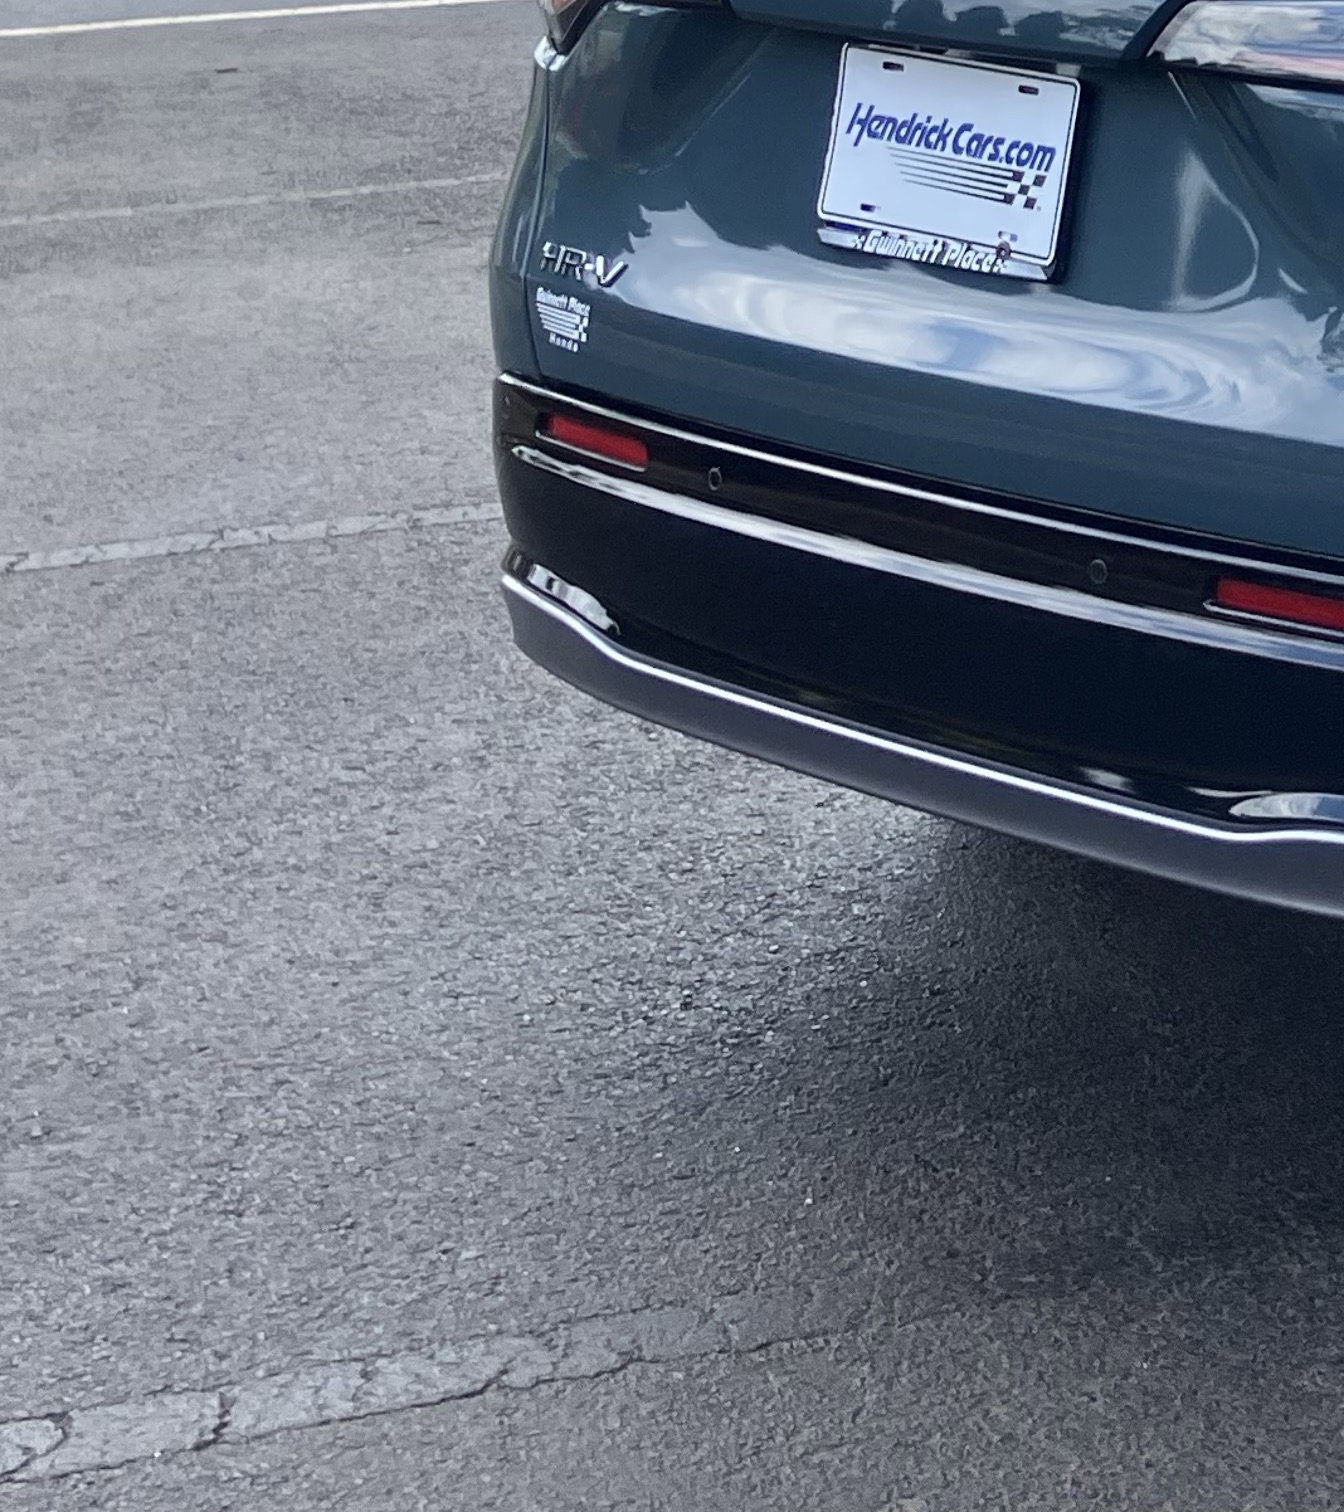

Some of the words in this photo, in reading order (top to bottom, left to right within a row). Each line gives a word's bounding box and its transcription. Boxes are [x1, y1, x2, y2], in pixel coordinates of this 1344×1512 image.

[846, 102, 1057, 172] HendrickCars.com
[540, 241, 625, 285] HR-V
[863, 229, 942, 264] Gwinnett
[941, 240, 997, 273] Place
